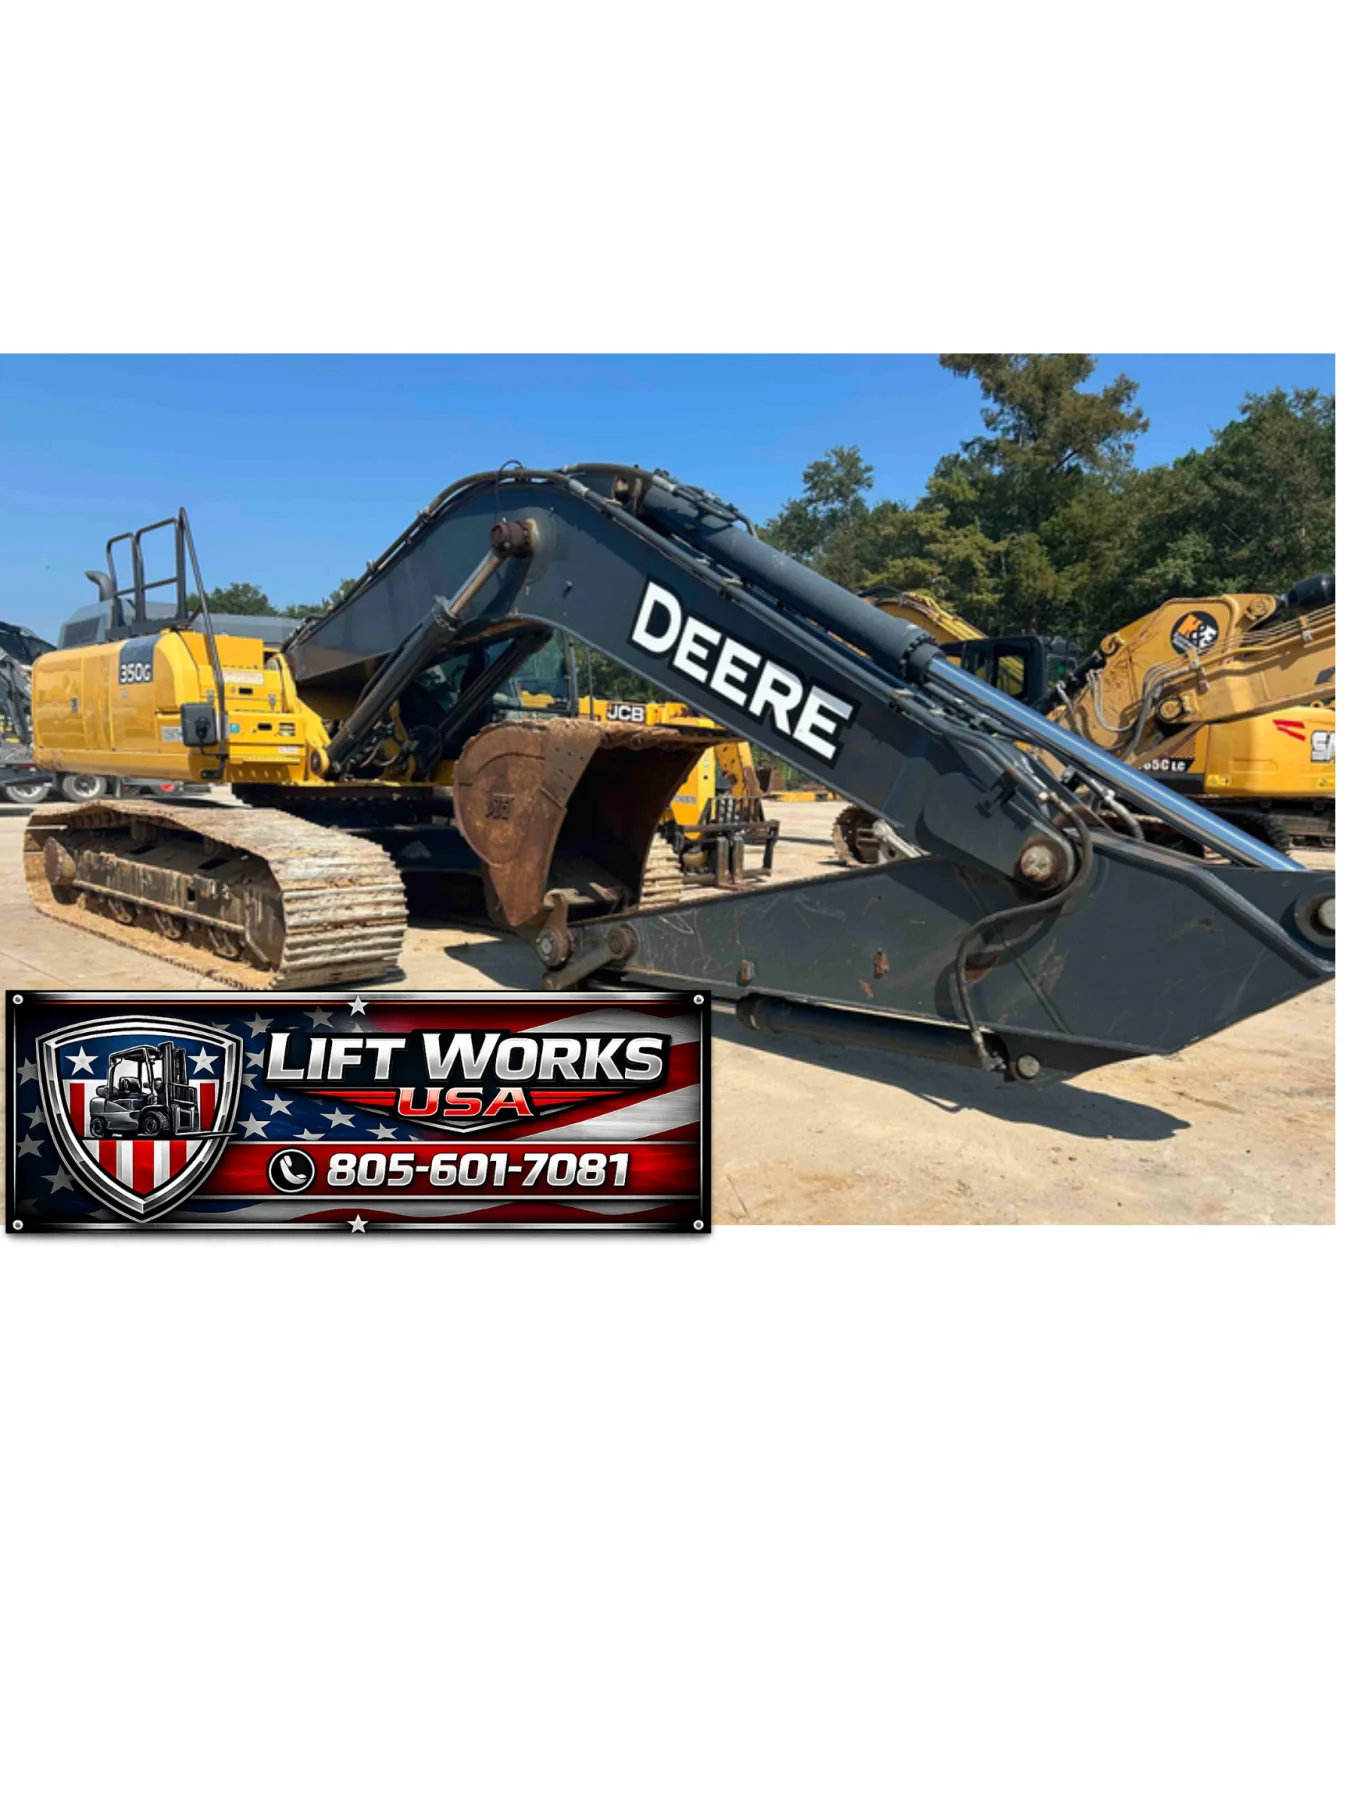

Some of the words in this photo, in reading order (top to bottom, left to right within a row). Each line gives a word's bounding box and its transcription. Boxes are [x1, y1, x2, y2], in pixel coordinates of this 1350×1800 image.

[120, 662, 152, 682] 350G
[632, 582, 853, 760] DEERE
[607, 704, 645, 722] JCB
